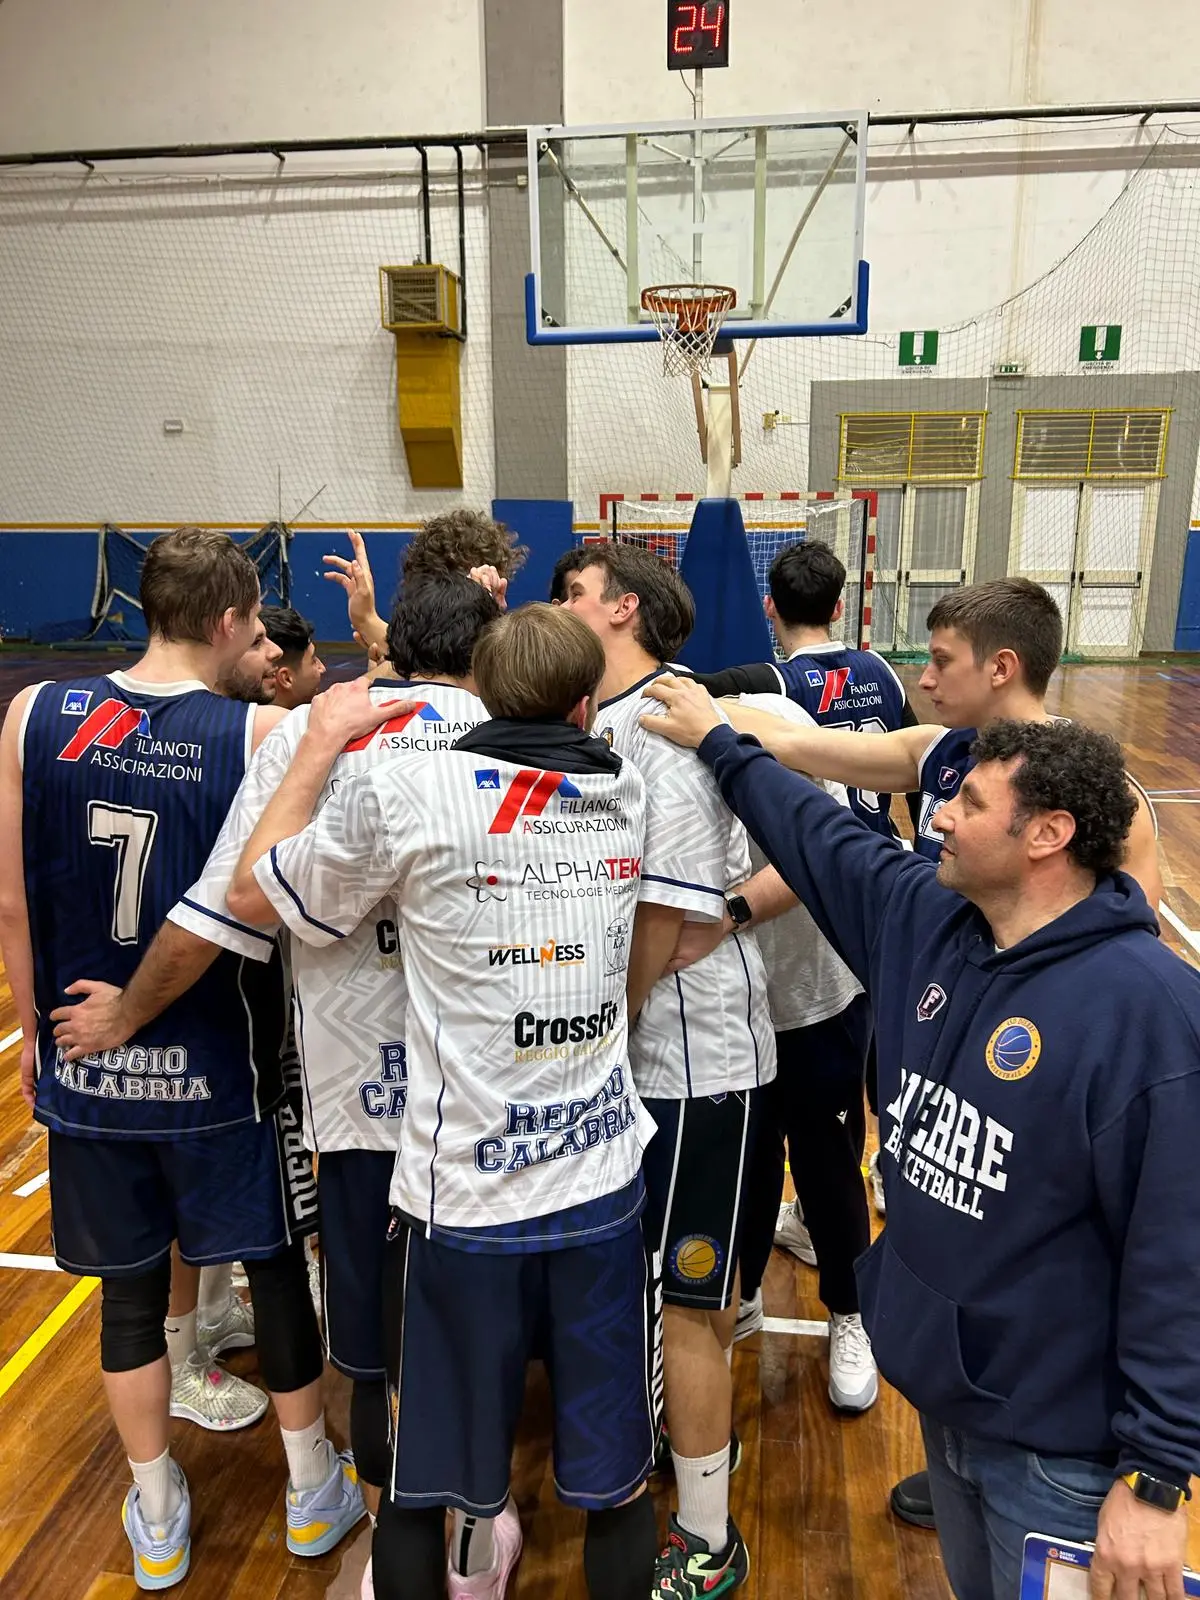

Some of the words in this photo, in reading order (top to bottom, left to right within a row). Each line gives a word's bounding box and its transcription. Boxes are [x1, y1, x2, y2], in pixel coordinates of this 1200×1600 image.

[674, 5, 723, 52] 24
[65, 701, 83, 711] AXA
[477, 780, 497, 788] AXA
[942, 770, 953, 782] F
[522, 817, 628, 835] ASSICURAZIONI
[87, 800, 159, 946] 7
[520, 857, 641, 886] ALPHATEK
[526, 886, 603, 901] TECNOLOGIE
[488, 938, 585, 968] WELLNESS
[922, 988, 941, 1010] F
[514, 1001, 618, 1048] CrossFit
[515, 1046, 569, 1063] REGGIO
